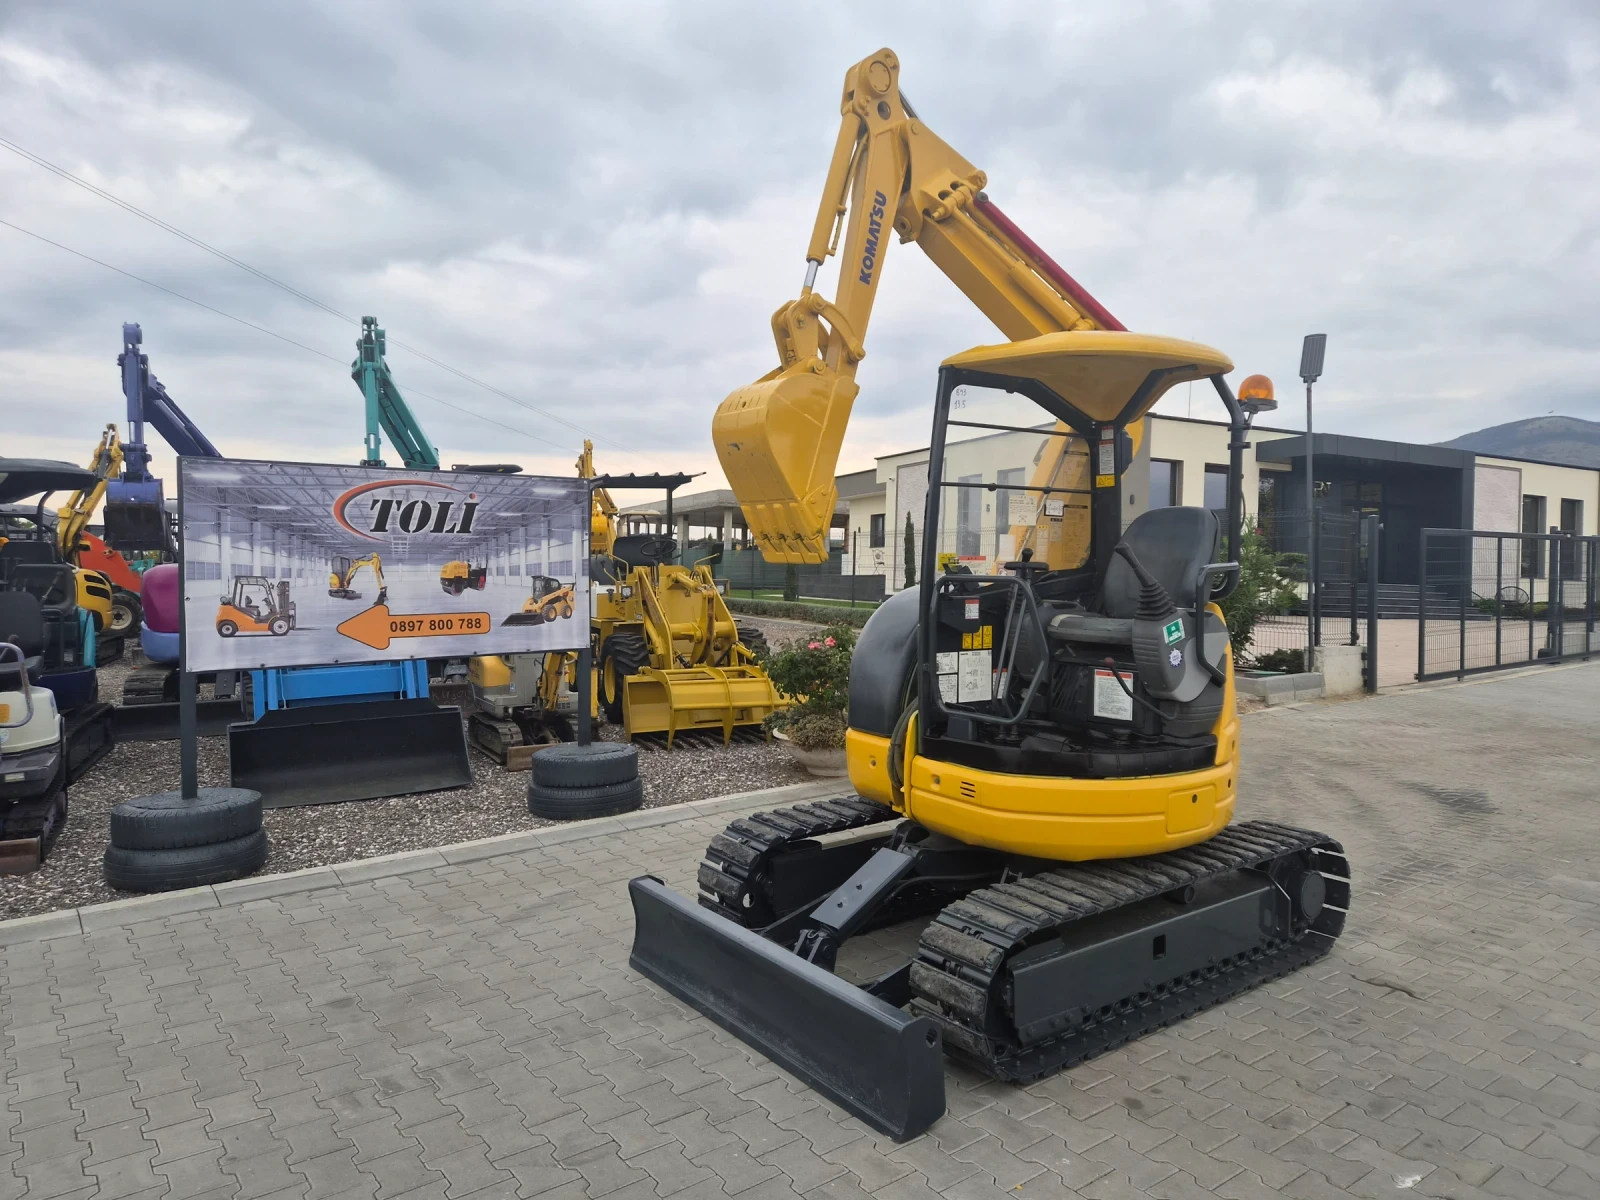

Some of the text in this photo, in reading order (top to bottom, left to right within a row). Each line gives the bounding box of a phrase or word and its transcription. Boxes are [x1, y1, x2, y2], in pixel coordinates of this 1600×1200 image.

[859, 190, 887, 285] KOMATSU
[370, 494, 480, 534] TOLI
[390, 617, 482, 633] 0897 800 788
